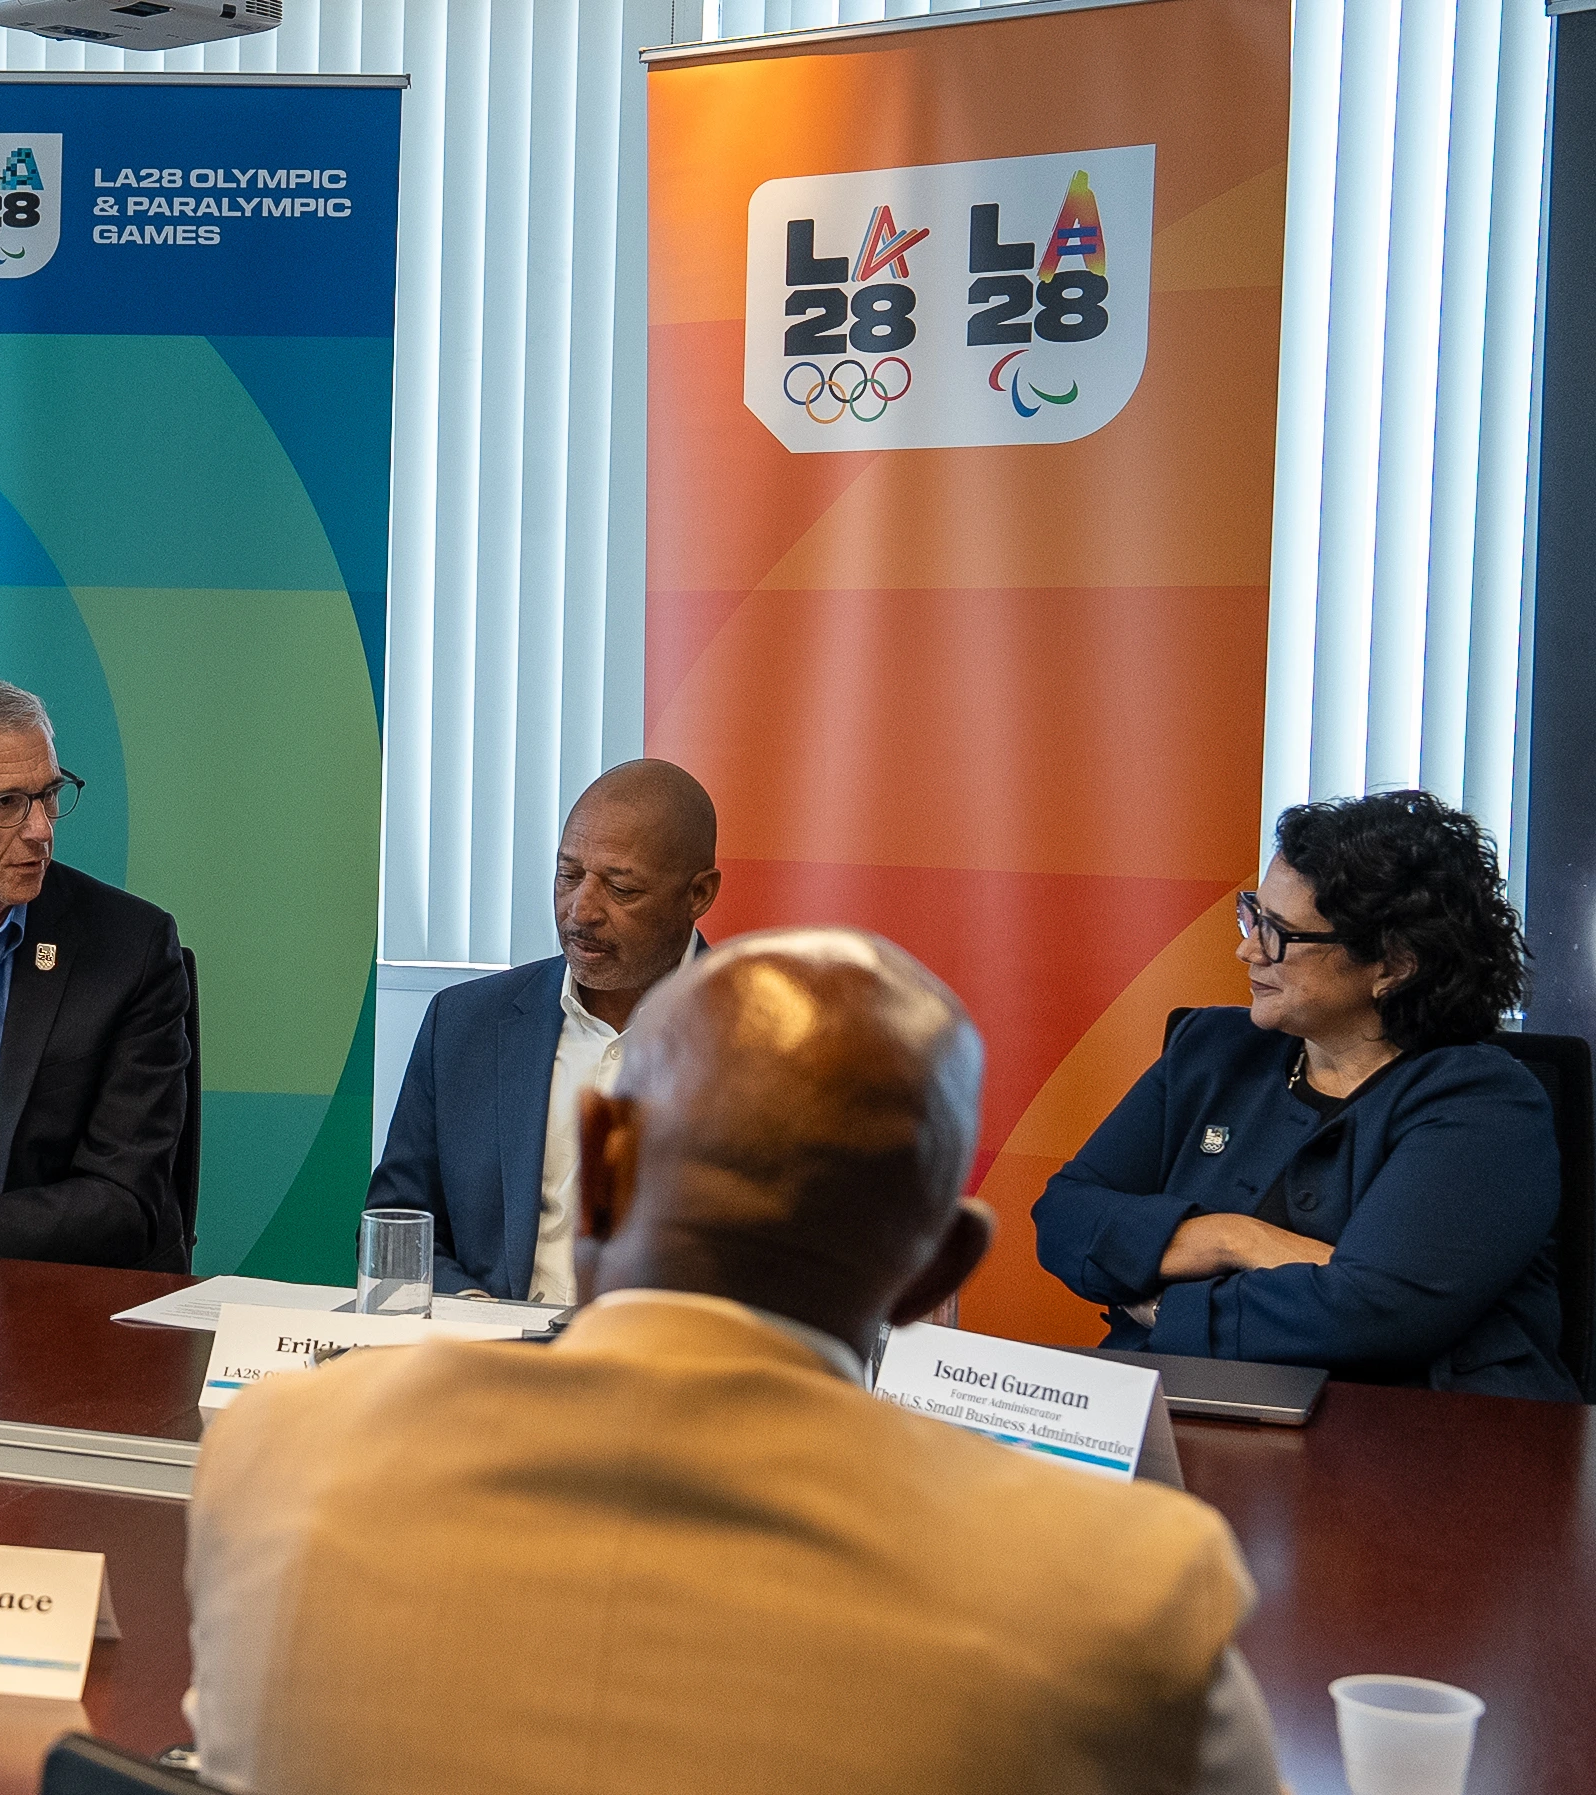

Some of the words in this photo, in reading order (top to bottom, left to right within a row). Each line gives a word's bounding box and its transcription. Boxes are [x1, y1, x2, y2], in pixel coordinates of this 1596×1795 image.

[94, 169, 183, 189] LA28
[189, 169, 348, 189] OLYMPIC
[92, 197, 120, 217] &
[127, 197, 352, 218] PARALYMPIC
[969, 169, 1106, 283] LA
[92, 225, 221, 245] GAMES
[786, 205, 930, 286] LA
[784, 283, 917, 357] 28
[966, 270, 1109, 347] 28
[223, 1366, 261, 1381] LA28
[933, 1359, 998, 1390] Isabel
[1001, 1373, 1090, 1410] Guzman
[899, 1392, 922, 1410] U.S.
[924, 1398, 963, 1418] Small
[965, 1407, 1025, 1433] Business
[950, 1388, 988, 1405] Former
[988, 1397, 1062, 1422] Administrator
